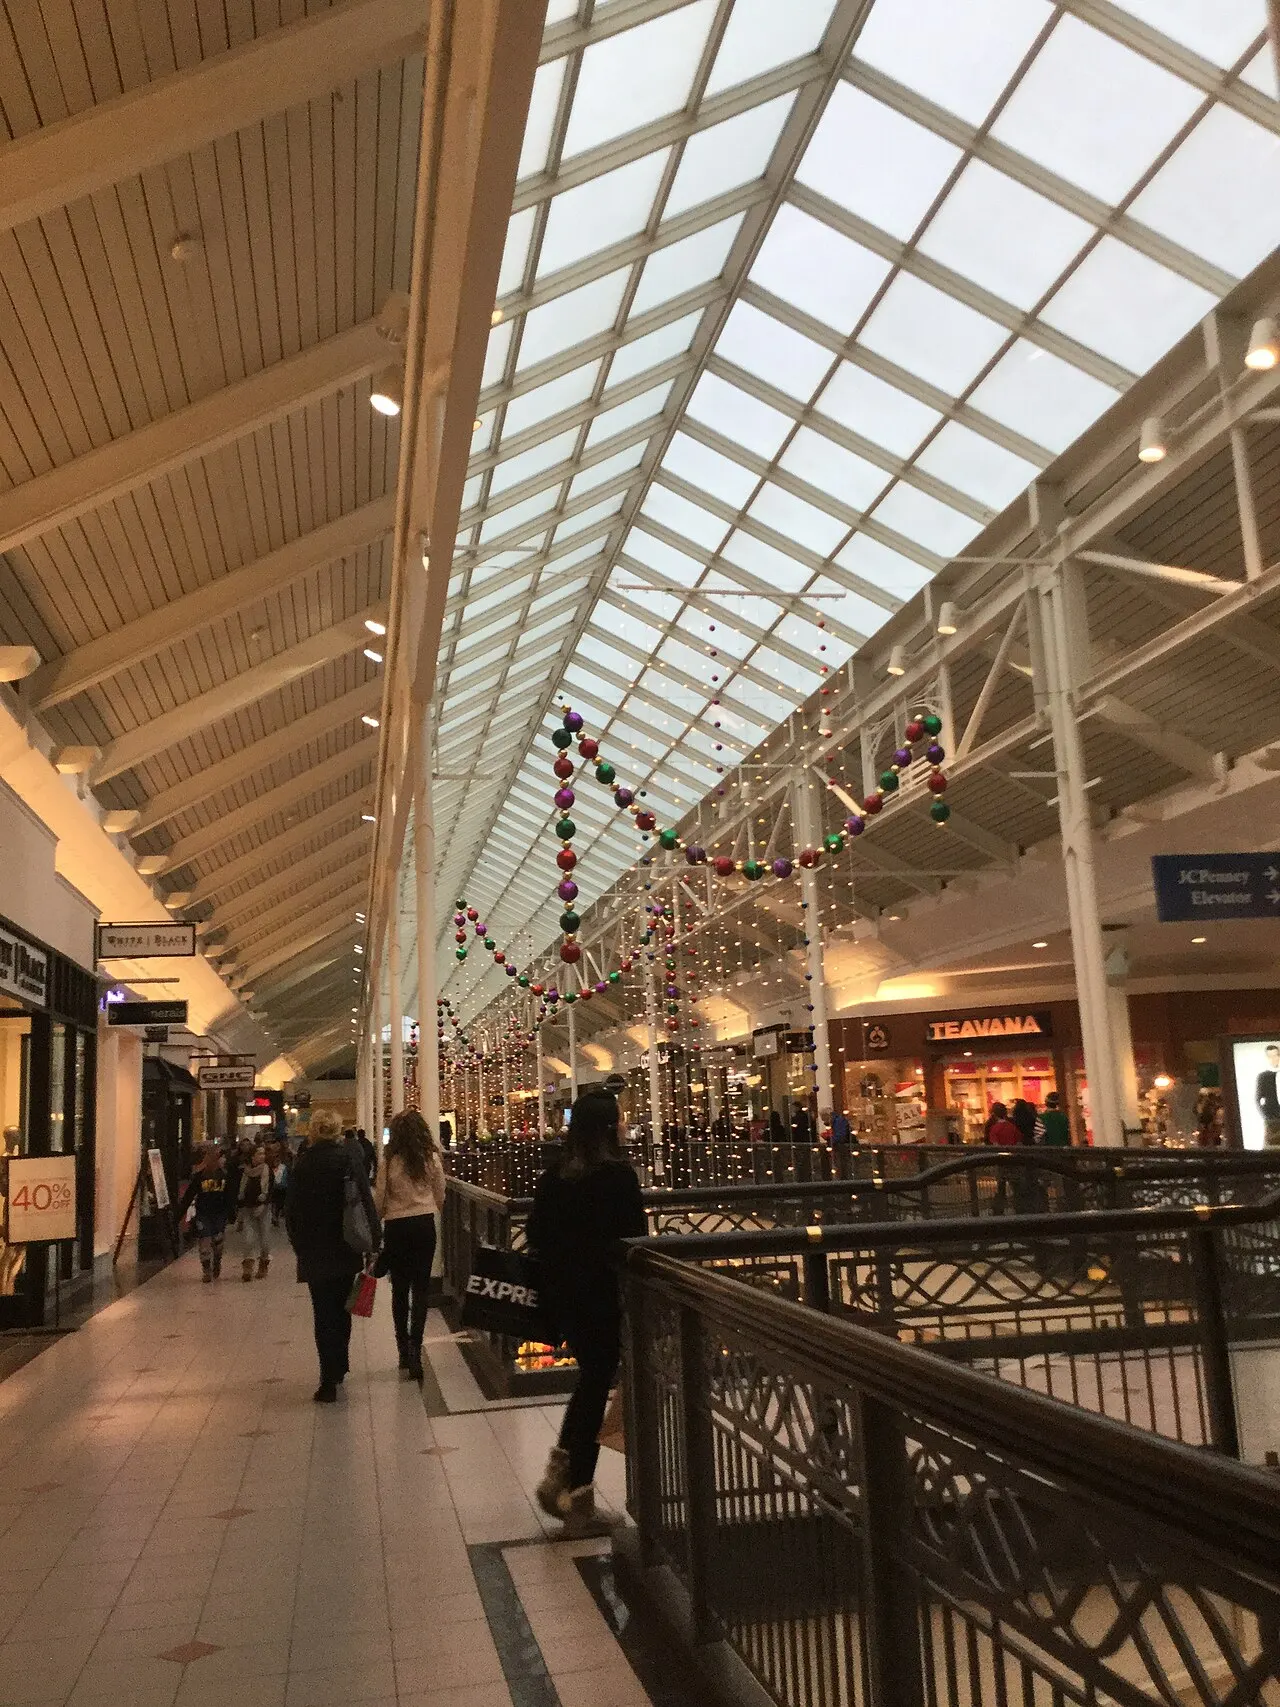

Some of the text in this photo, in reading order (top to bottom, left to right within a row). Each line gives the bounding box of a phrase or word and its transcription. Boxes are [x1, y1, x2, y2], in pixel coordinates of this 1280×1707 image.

[1178, 869, 1251, 886] JCPenney
[1191, 891, 1252, 905] Elevator
[929, 1015, 1041, 1040] TEAVANA
[202, 1072, 252, 1080] GNC
[12, 1183, 72, 1211] 40%
[52, 1200, 72, 1210] OFF
